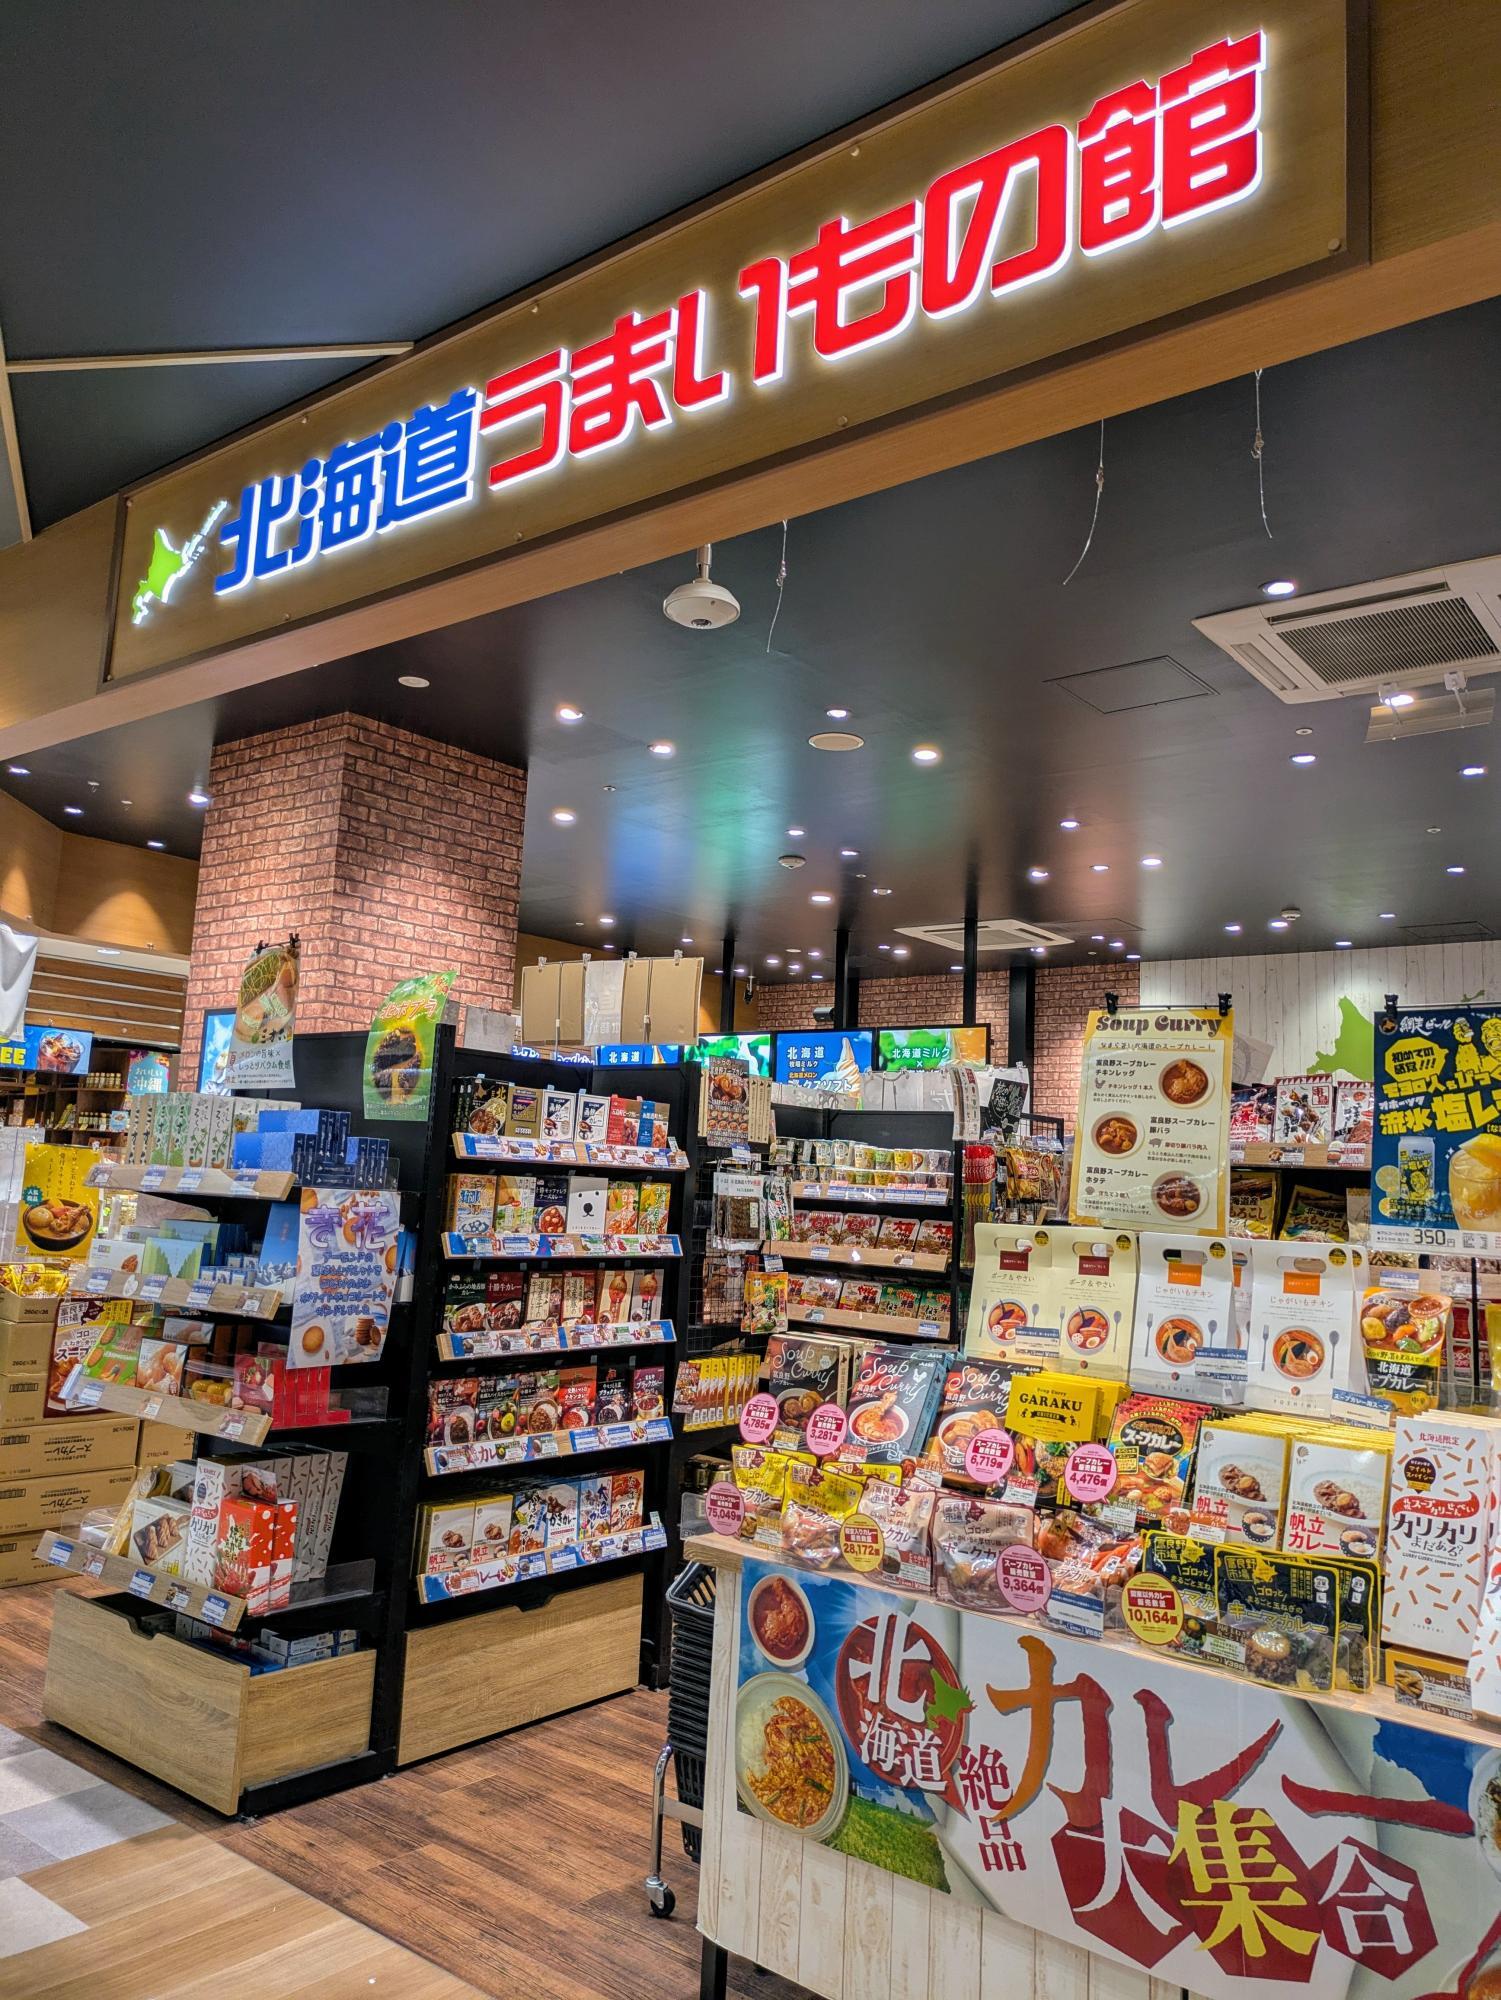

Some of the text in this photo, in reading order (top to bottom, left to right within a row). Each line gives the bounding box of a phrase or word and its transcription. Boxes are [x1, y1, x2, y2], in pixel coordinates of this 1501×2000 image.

[1095, 1015, 1223, 1038] Soup Curry
[609, 1051, 641, 1064] 北海道
[787, 1046, 825, 1060] 北海道
[892, 1047, 950, 1059] 北海道ミルク
[1392, 1047, 1435, 1063] 初めての
[1095, 1059, 1157, 1067] 富良野スープカレー
[1095, 1069, 1135, 1077] チキンレッグ
[133, 1076, 162, 1092] 沖縄
[1378, 1096, 1425, 1111] オホーツク
[1150, 1116, 1215, 1127] 富良野スープカレー
[1149, 1126, 1170, 1135] 豚バラ
[1086, 1166, 1149, 1177] 富良野スープカレー
[1086, 1177, 1106, 1185] ホタテ
[1231, 1196, 1258, 1206] 海道産
[1155, 1286, 1214, 1298] じゃがいもチキン
[1269, 1296, 1336, 1308] じゃがいもチキン
[773, 1341, 815, 1369] Soup
[790, 1360, 835, 1391] Curry
[860, 1357, 909, 1383] Soup
[1377, 1361, 1413, 1376] 北海道
[948, 1365, 1001, 1391] Soup
[878, 1374, 927, 1404] Curry
[1019, 1393, 1083, 1412] GARAKU
[748, 1405, 776, 1416] スープカレー
[743, 1416, 770, 1431] 4,785個
[815, 1415, 842, 1424] スープカレー
[810, 1430, 839, 1442] 3,281個
[1122, 1428, 1182, 1449] スープカレー
[1418, 1432, 1461, 1446] 北海道限定
[975, 1441, 1008, 1450] スープカレー
[970, 1454, 1003, 1470] 6,719個
[1073, 1456, 1111, 1472] スープカレー
[1069, 1473, 1108, 1488] 4,476個
[740, 1486, 782, 1504] ープカレー
[1196, 1495, 1229, 1516] 帆立
[707, 1507, 742, 1522] 75,049個
[1289, 1511, 1325, 1536] 帆立
[1391, 1513, 1478, 1546] カリカリ
[1287, 1532, 1340, 1551] カレー
[843, 1542, 880, 1557] 28,172個
[1156, 1549, 1178, 1560] 市場
[1004, 1558, 1042, 1571] スープカレー
[1182, 1566, 1209, 1577] ゴロッと
[1225, 1557, 1257, 1571] 富良野
[1227, 1568, 1251, 1581] 市場
[1003, 1577, 1044, 1595] 9,364個
[1256, 1586, 1284, 1598] ゴロッと
[1247, 1594, 1304, 1615] まるごと玉ねぎの
[1127, 1608, 1179, 1626] 10,164個
[1227, 1599, 1329, 1634] キーマカレー
[986, 1635, 1476, 1839] カレー
[959, 1743, 1027, 1873] 絶品
[1066, 1800, 1415, 1958] 大集合
